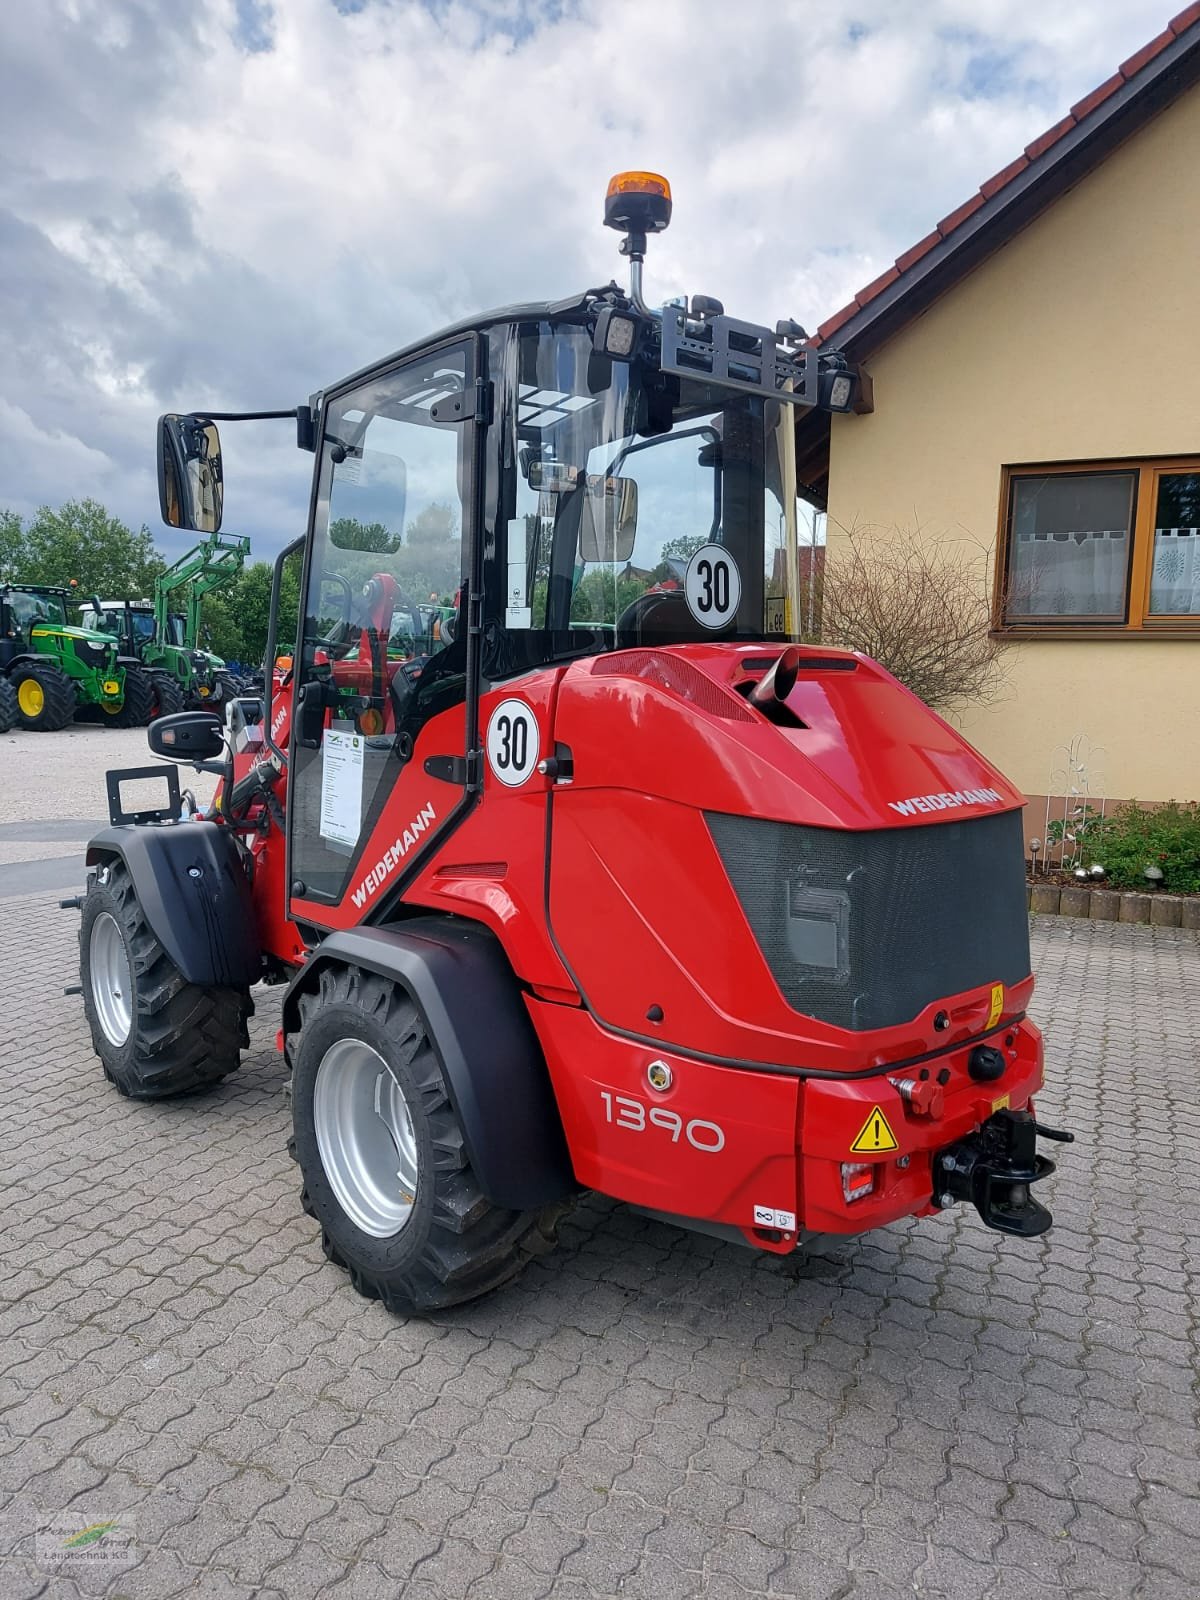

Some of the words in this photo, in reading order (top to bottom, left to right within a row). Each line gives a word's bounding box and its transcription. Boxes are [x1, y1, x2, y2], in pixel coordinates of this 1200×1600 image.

[697, 559, 729, 613] 30
[248, 705, 288, 773] WEIDEANN
[497, 715, 528, 772] 30
[888, 788, 1004, 817] WEIDEMANN
[350, 801, 437, 909] WEIDEMANN
[600, 1091, 726, 1153] 1390
